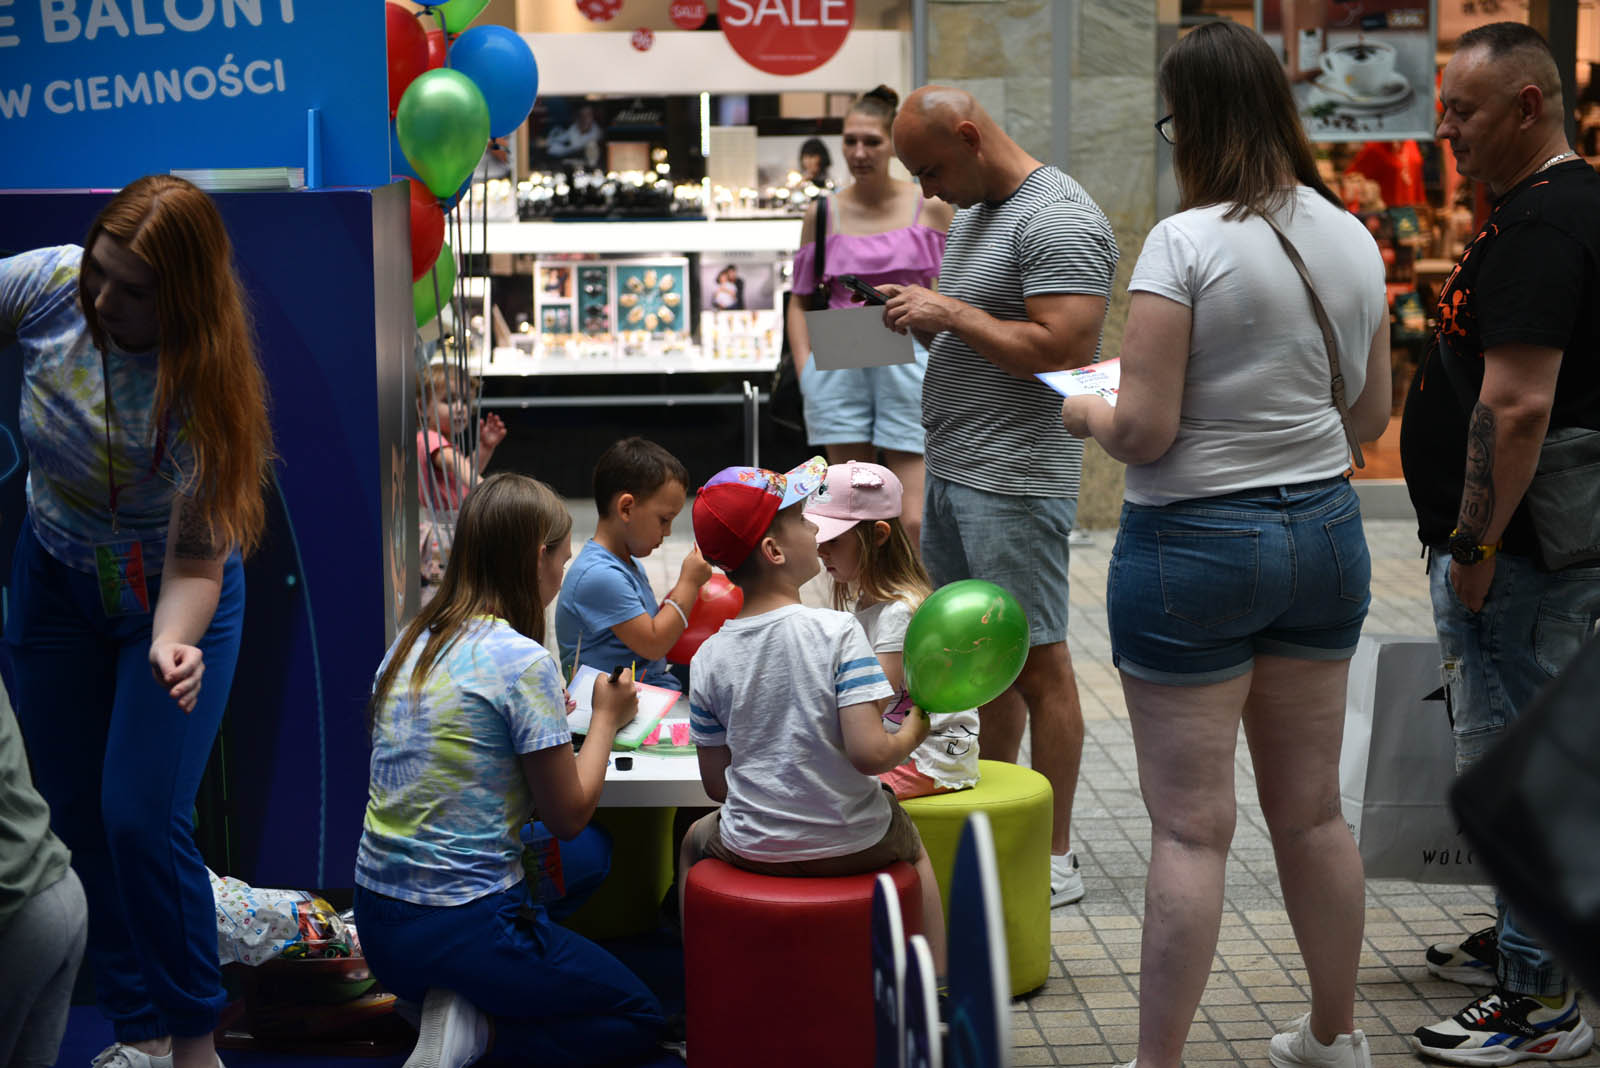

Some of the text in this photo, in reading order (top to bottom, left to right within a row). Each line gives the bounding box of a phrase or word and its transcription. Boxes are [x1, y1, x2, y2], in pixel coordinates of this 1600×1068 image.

[674, 5, 704, 18] SALE
[725, 0, 849, 26] SALE
[44, 53, 286, 114] CIEMNOŚCI
